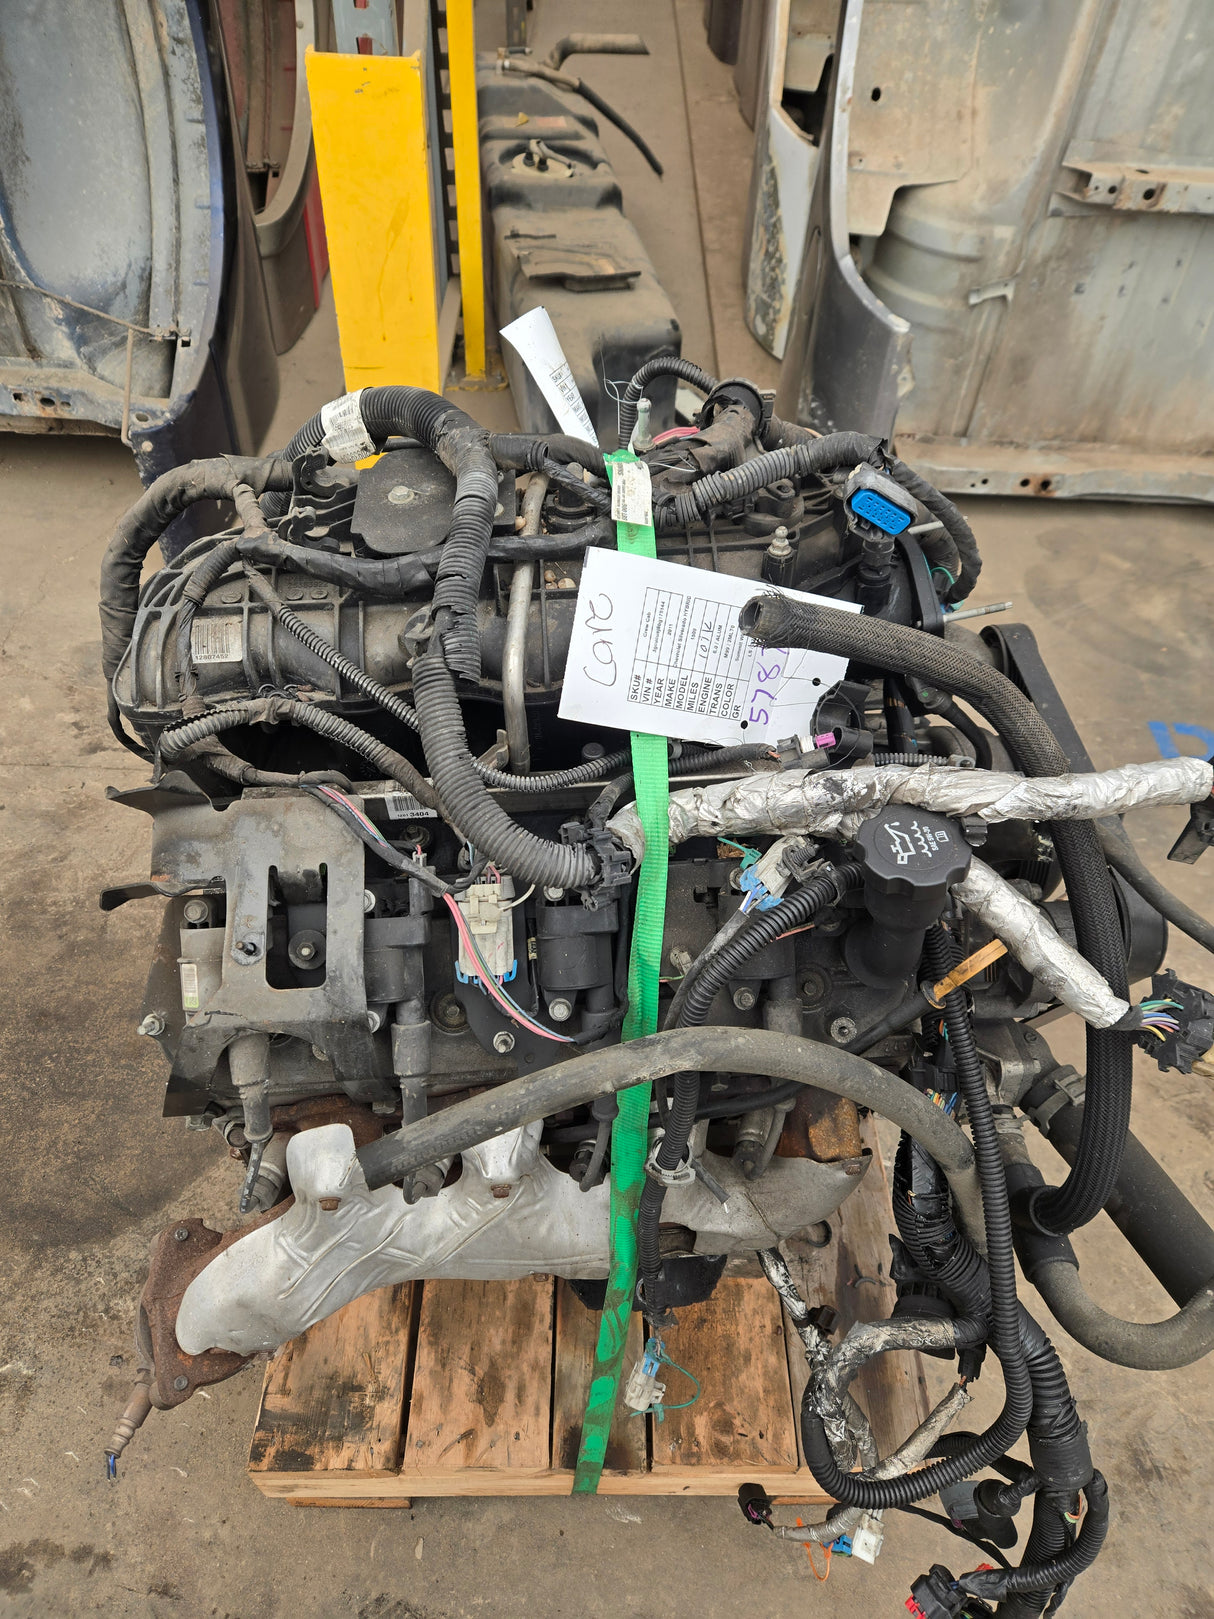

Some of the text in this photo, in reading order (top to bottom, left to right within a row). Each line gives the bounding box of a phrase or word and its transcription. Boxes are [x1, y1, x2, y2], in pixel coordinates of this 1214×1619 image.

[664, 596, 692, 707] MAKE Chevrolet Silverado HYBRID
[630, 674, 642, 701] SKU#
[642, 686, 652, 702] VIN
[653, 678, 665, 704] YEAR
[675, 675, 689, 709] MODEL
[721, 682, 735, 717] COLOR
[735, 642, 743, 662] Summit
[687, 682, 699, 711] MILES
[698, 677, 713, 713] ENGINE
[709, 683, 723, 714] TRANS
[732, 705, 741, 719] GR
[930, 841, 939, 851] SAE
